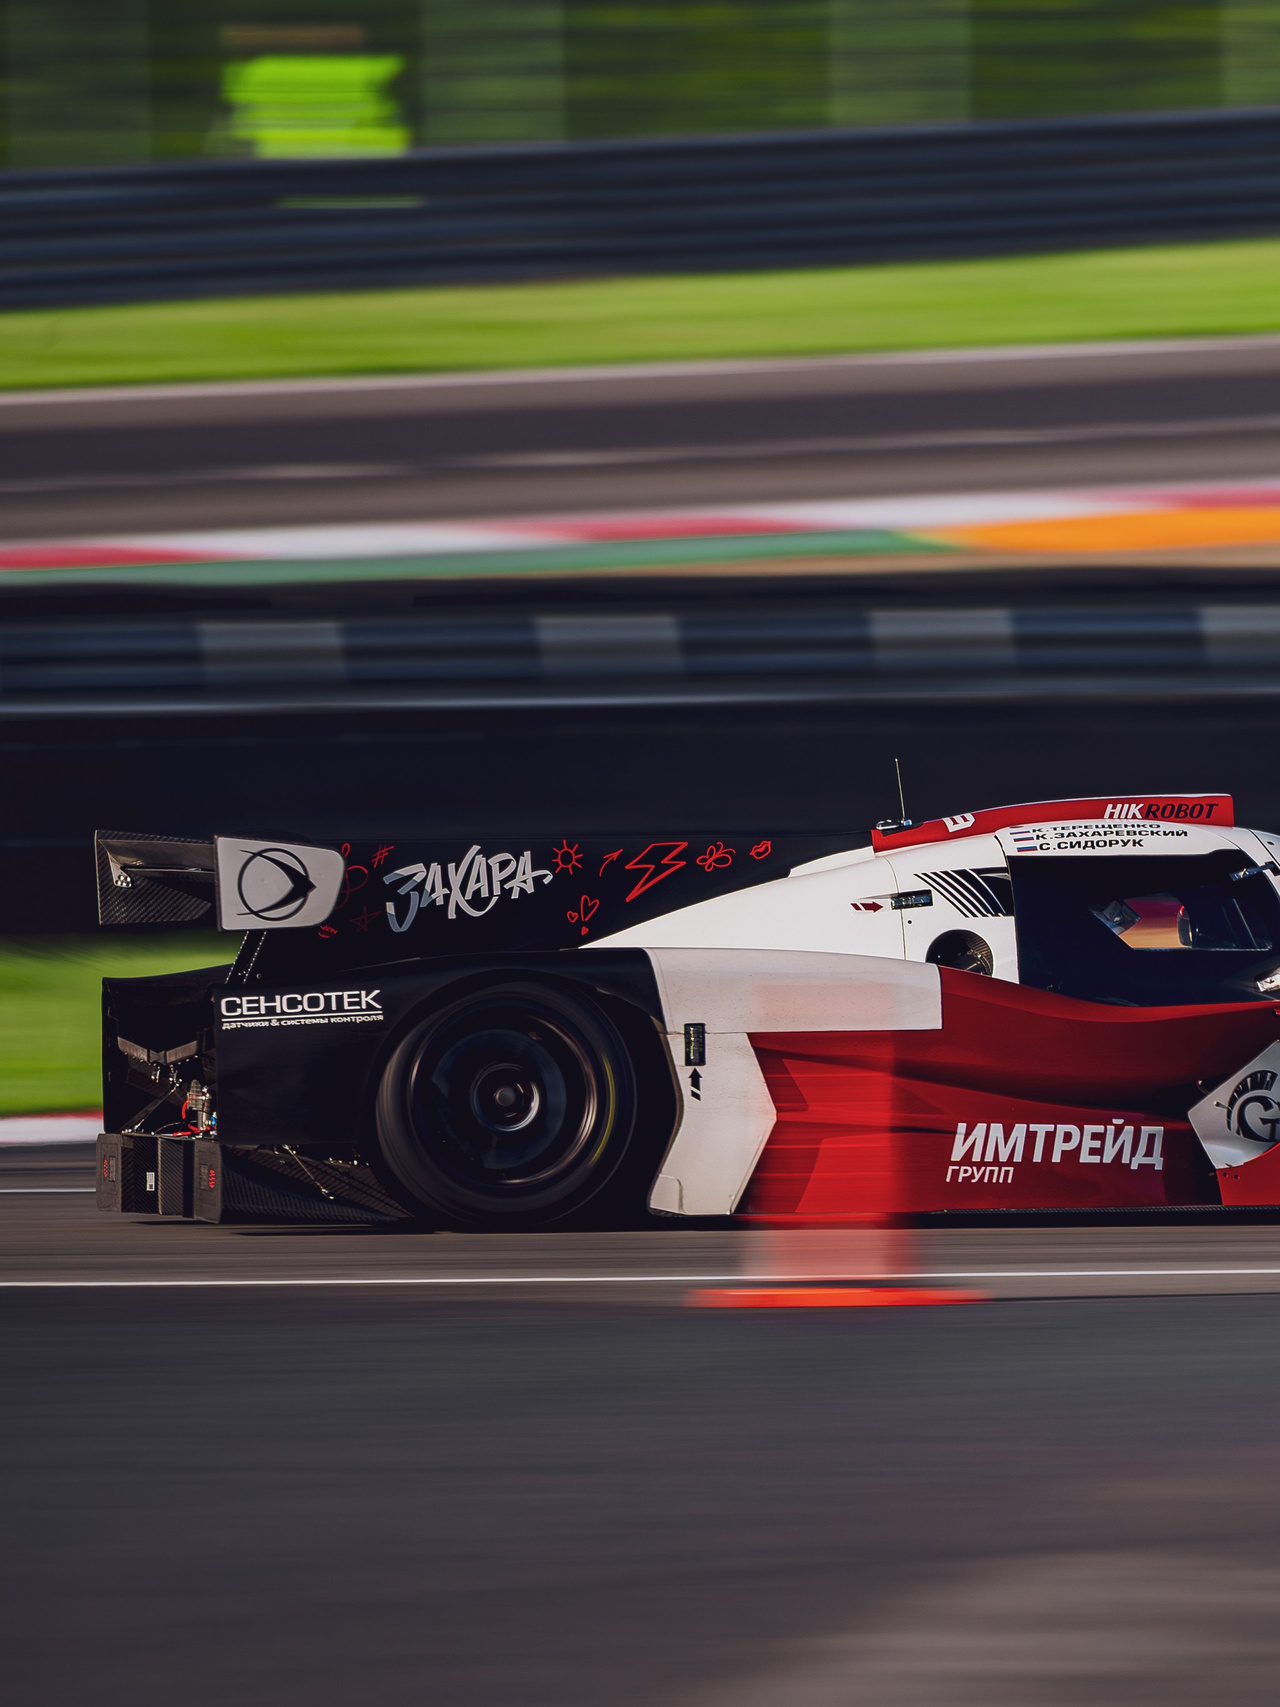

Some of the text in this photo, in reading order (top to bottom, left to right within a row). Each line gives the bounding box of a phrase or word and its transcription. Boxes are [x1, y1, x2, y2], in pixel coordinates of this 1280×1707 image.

[220, 990, 382, 1016] СЕНСОТЕК
[222, 1021, 269, 1030] датчики
[281, 1016, 328, 1026] системы
[330, 1014, 384, 1024] контроля
[950, 1118, 1164, 1170] ИМТРЕЙД
[945, 1165, 1014, 1183] ГРУПП
